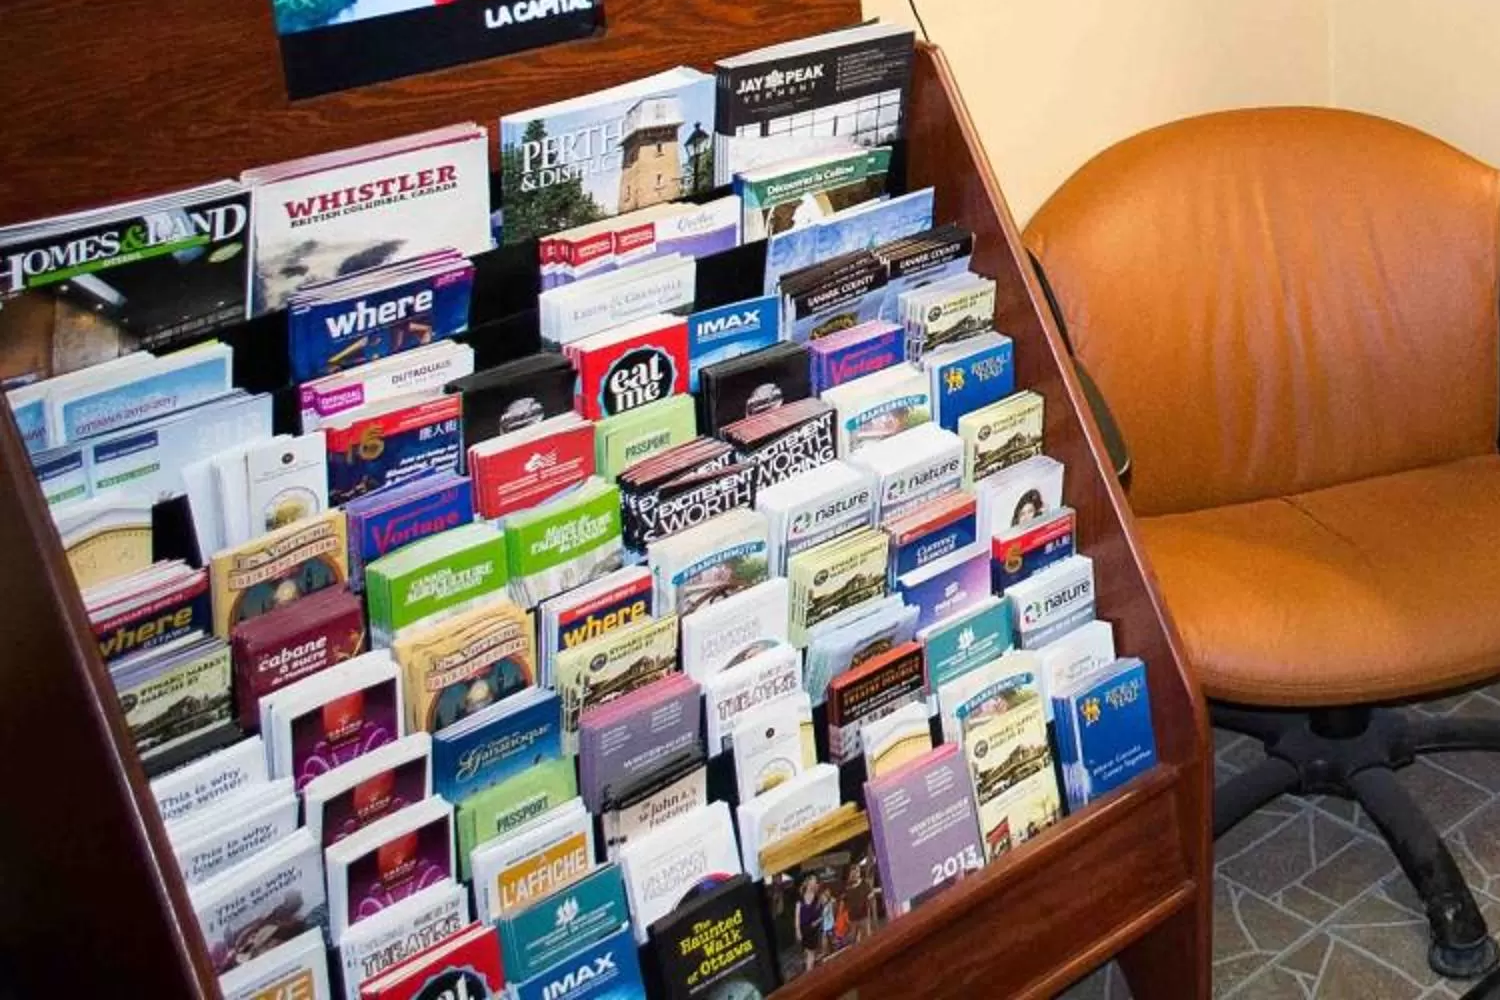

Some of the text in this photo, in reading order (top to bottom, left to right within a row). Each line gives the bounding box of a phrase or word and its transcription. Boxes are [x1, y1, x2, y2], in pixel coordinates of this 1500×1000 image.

[485, 6, 515, 28] LA
[736, 77, 766, 95] JAY
[785, 64, 825, 85] PEAK
[743, 82, 817, 104] VERMONT
[521, 119, 625, 174] PERTH
[283, 165, 458, 219] WHISTLER
[520, 172, 536, 192] &
[290, 209, 342, 229] BRITISH
[0, 231, 120, 293] HOMES
[141, 203, 247, 248] LAND
[325, 289, 433, 340] where
[697, 309, 761, 337] IMAX
[609, 352, 664, 394] eat
[615, 381, 661, 412] me
[624, 431, 672, 459] PASSPORT
[749, 410, 834, 465] EXCITEMENT
[658, 467, 755, 517] EXCITEMENT
[908, 458, 960, 490] nature
[660, 490, 752, 535] WORTH
[815, 488, 870, 524] nature
[1043, 580, 1091, 614] nature
[563, 599, 647, 650] where
[258, 635, 328, 673] cabane
[291, 649, 328, 671] sucre
[161, 790, 190, 809] This
[211, 767, 241, 787] why
[650, 795, 680, 819] John
[496, 795, 550, 834] PASSPORT
[192, 845, 222, 863] This
[242, 822, 273, 843] why
[193, 856, 223, 876] love
[501, 845, 588, 909] L'AFFICHE
[930, 843, 978, 886] 2013
[215, 896, 246, 917] This
[266, 865, 297, 886] why
[219, 905, 248, 926] love
[680, 909, 744, 956] Haunted
[693, 913, 712, 933] The
[699, 938, 753, 979] Ottawa
[703, 930, 743, 958] Walk
[542, 951, 616, 1000] IMAX
